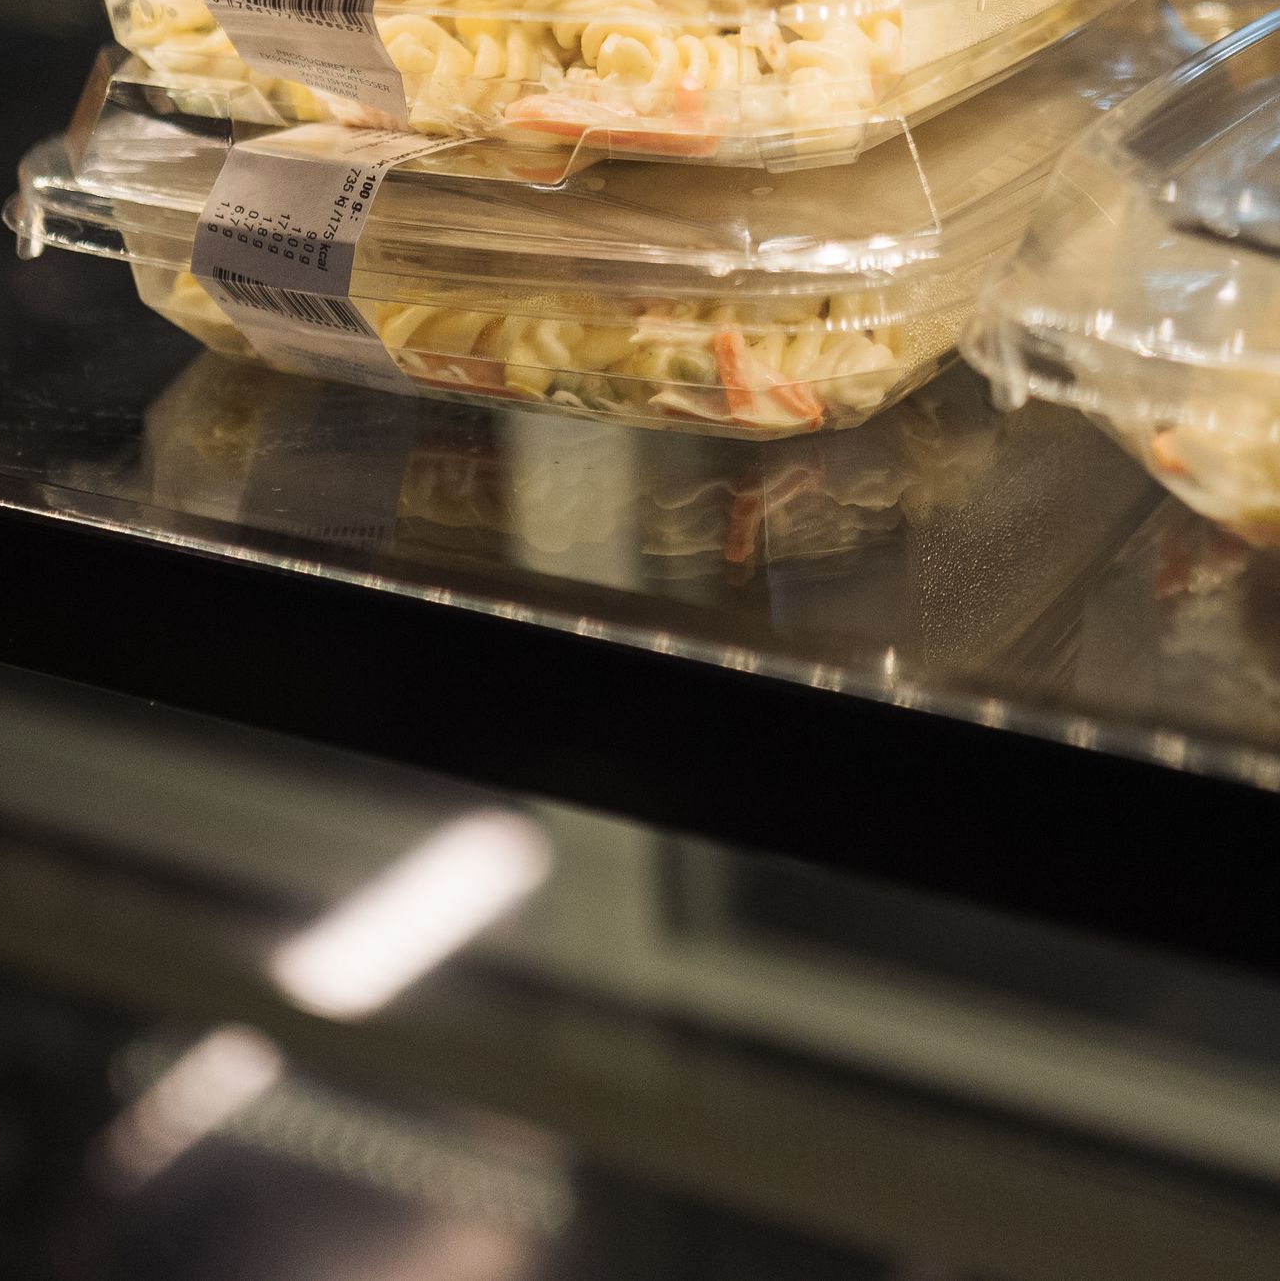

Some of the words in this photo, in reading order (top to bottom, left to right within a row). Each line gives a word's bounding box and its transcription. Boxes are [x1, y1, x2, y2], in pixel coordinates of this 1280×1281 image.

[342, 168, 362, 193] 735
[359, 174, 377, 200] 100
[207, 221, 219, 234] g
[222, 227, 234, 239] g
[237, 232, 249, 244] g
[252, 238, 263, 249] g
[267, 243, 279, 255] g
[283, 248, 295, 260] g
[298, 254, 310, 266] g
[317, 242, 332, 273] kcal
